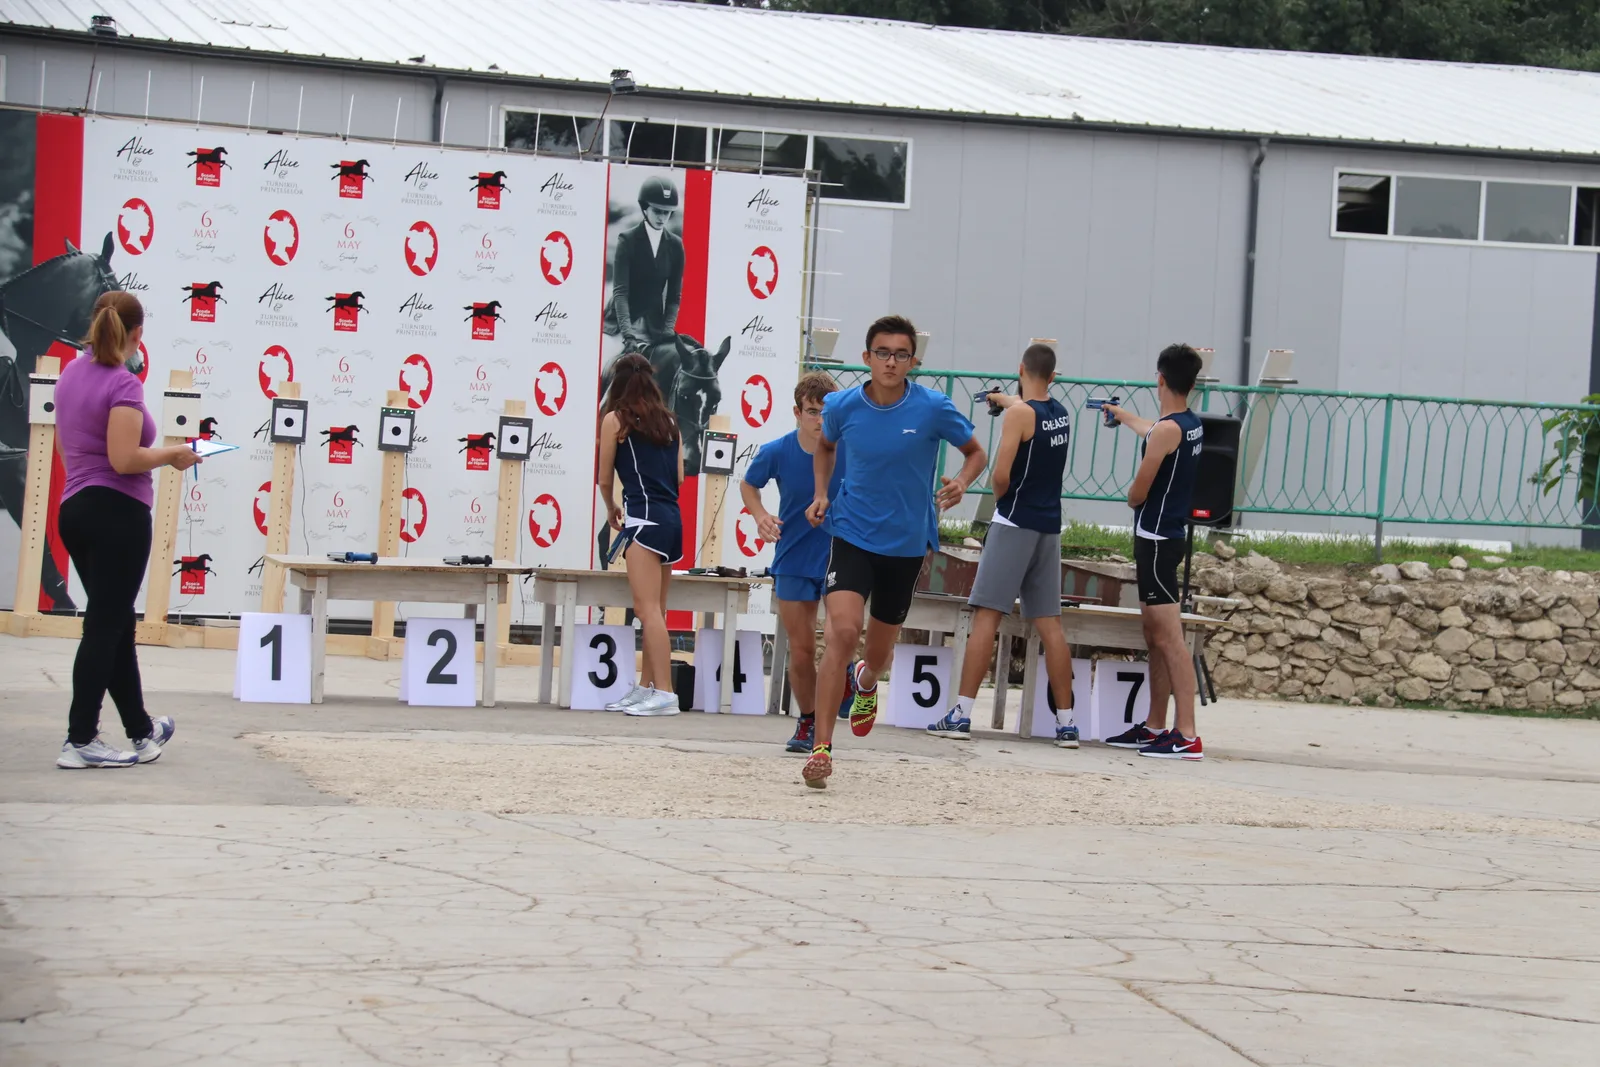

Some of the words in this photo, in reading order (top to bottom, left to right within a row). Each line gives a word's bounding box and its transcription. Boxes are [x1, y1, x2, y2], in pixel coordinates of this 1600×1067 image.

[116, 136, 154, 162] Alice
[264, 149, 299, 175] Alice
[404, 161, 439, 186] Alice
[540, 172, 574, 197] Alice
[748, 188, 780, 212] Alice
[201, 210, 212, 228] 6
[194, 230, 219, 240] MAY
[344, 222, 354, 238] 6
[337, 240, 361, 250] MAY
[481, 232, 492, 249] 6
[475, 250, 497, 260] MAY
[258, 282, 294, 308] Alice
[399, 292, 434, 317] Alice
[535, 302, 568, 326] Alice
[741, 316, 773, 340] Alice
[196, 347, 207, 364] 6
[339, 356, 349, 372] 6
[189, 366, 214, 375] MAY
[332, 374, 355, 384] MAY
[476, 364, 486, 380] 6
[469, 383, 492, 391] MAY
[530, 432, 562, 456] Alice
[191, 484, 202, 501] 6
[333, 491, 344, 507] 6
[183, 503, 208, 512] MAY
[471, 497, 481, 513] 6
[326, 510, 350, 518] MAY
[464, 515, 487, 524] MAY
[260, 624, 282, 681] 1
[425, 628, 458, 684] 2
[588, 634, 618, 688] 3
[912, 656, 941, 708] 5
[1116, 672, 1144, 724] 7
[852, 713, 876, 727] BROOKS
